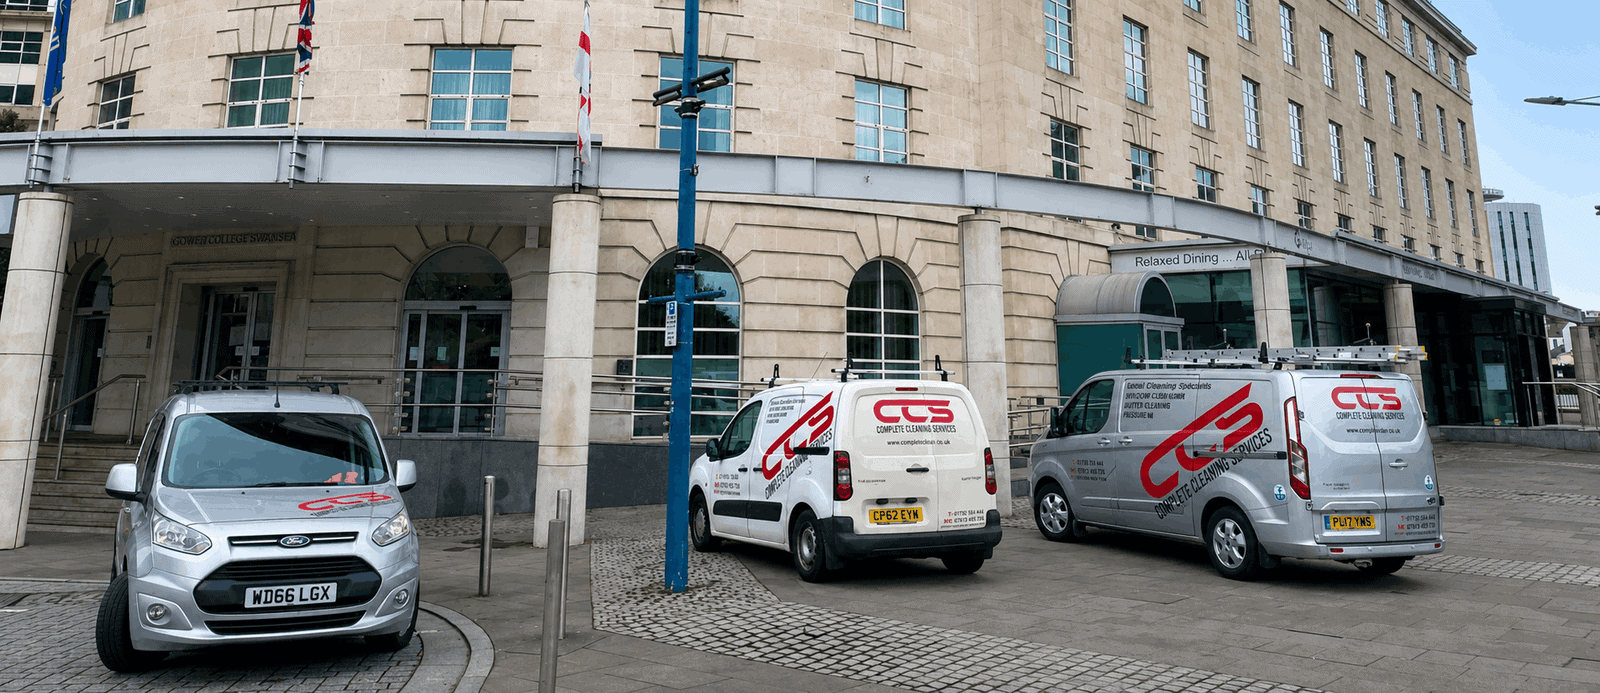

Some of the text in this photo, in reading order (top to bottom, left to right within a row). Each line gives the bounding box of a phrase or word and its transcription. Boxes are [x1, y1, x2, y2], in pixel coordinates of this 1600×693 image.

[172, 231, 296, 246] GOWER COLLEGE SWANSEA
[1135, 254, 1180, 267] Relaxed
[1183, 253, 1219, 265] Dining
[1146, 381, 1176, 391] Cleaning
[1331, 386, 1402, 410] CCS
[873, 399, 954, 423] CCS
[1335, 411, 1405, 420] COMPLETE CLEANING SERVICES
[762, 391, 834, 480] CCS
[876, 424, 956, 434] COMPLETE CLEANING SERVICES
[1140, 382, 1263, 498] CCS
[1154, 483, 1192, 520] COMPLETE
[1190, 457, 1230, 493] CLEANING
[298, 492, 392, 511] CCS
[873, 510, 898, 521] CP62
[1354, 516, 1371, 527] YNS
[252, 585, 331, 605] WD66 LGX
